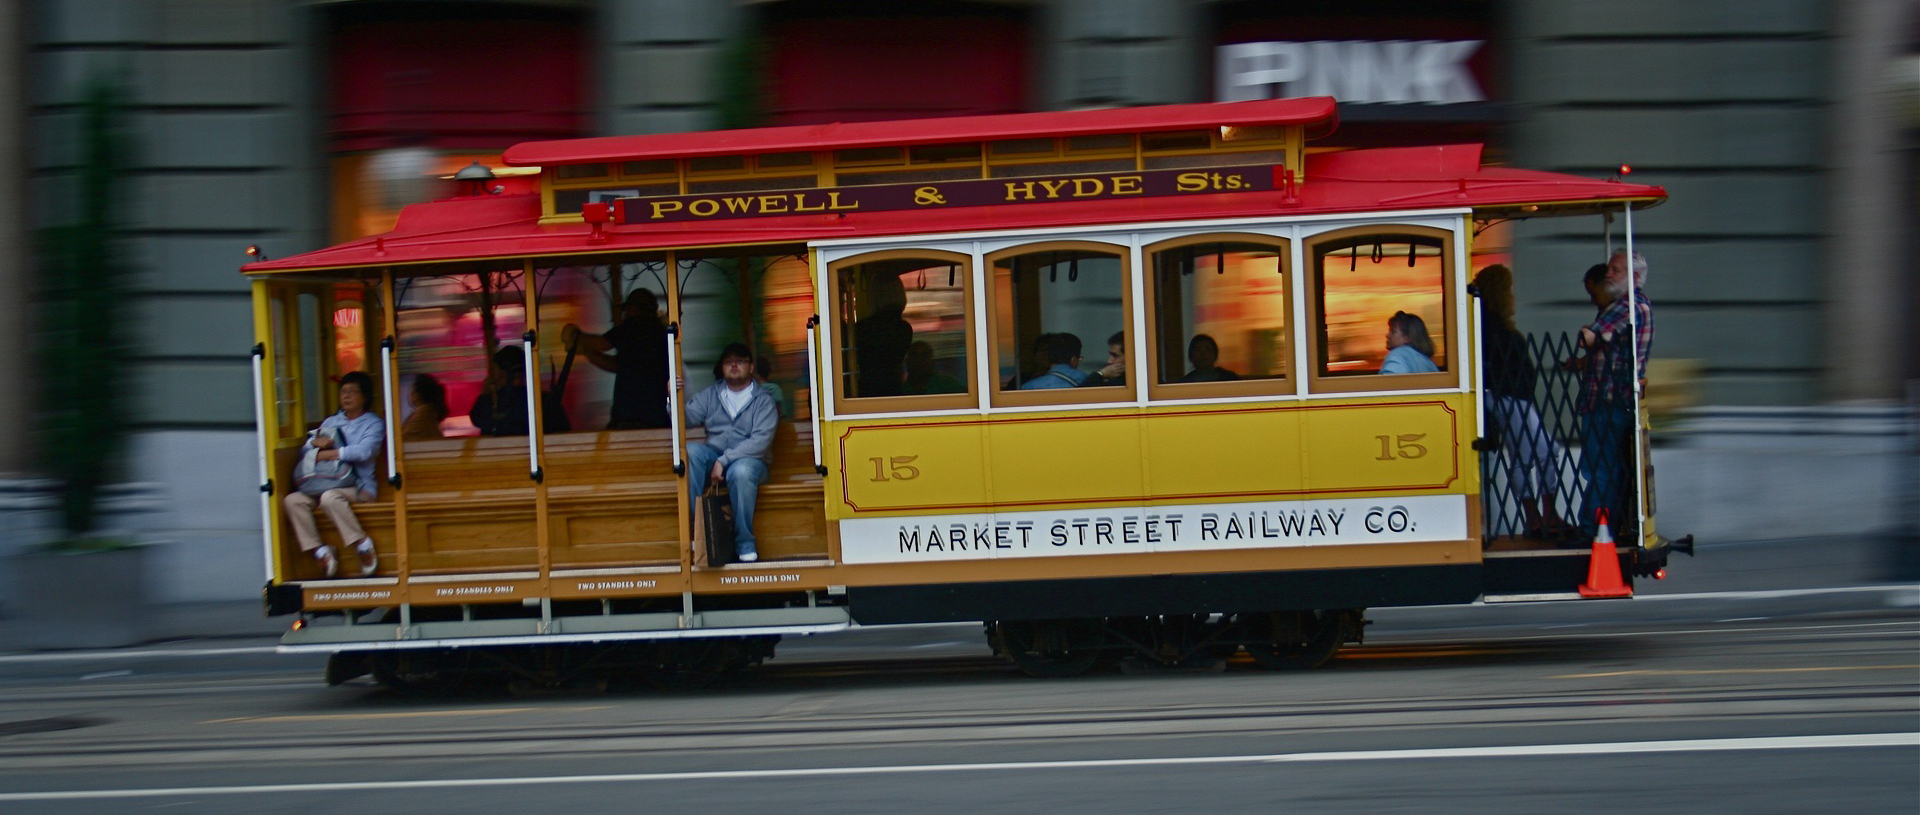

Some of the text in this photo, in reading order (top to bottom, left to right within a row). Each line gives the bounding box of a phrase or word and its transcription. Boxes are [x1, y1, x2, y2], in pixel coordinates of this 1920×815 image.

[650, 171, 1252, 219] POWELL & HYDE Sts.
[1374, 433, 1429, 461] 15
[868, 454, 921, 482] 15
[898, 505, 1417, 554] MARKET STREET RAILWAY CO.
[577, 579, 657, 591] TWO STANDEES ONLY
[720, 573, 801, 585] TWO STANDEES ONLY
[371, 590, 391, 599] ONLY
[436, 588, 454, 596] TWO
[495, 585, 515, 594] ONLY
